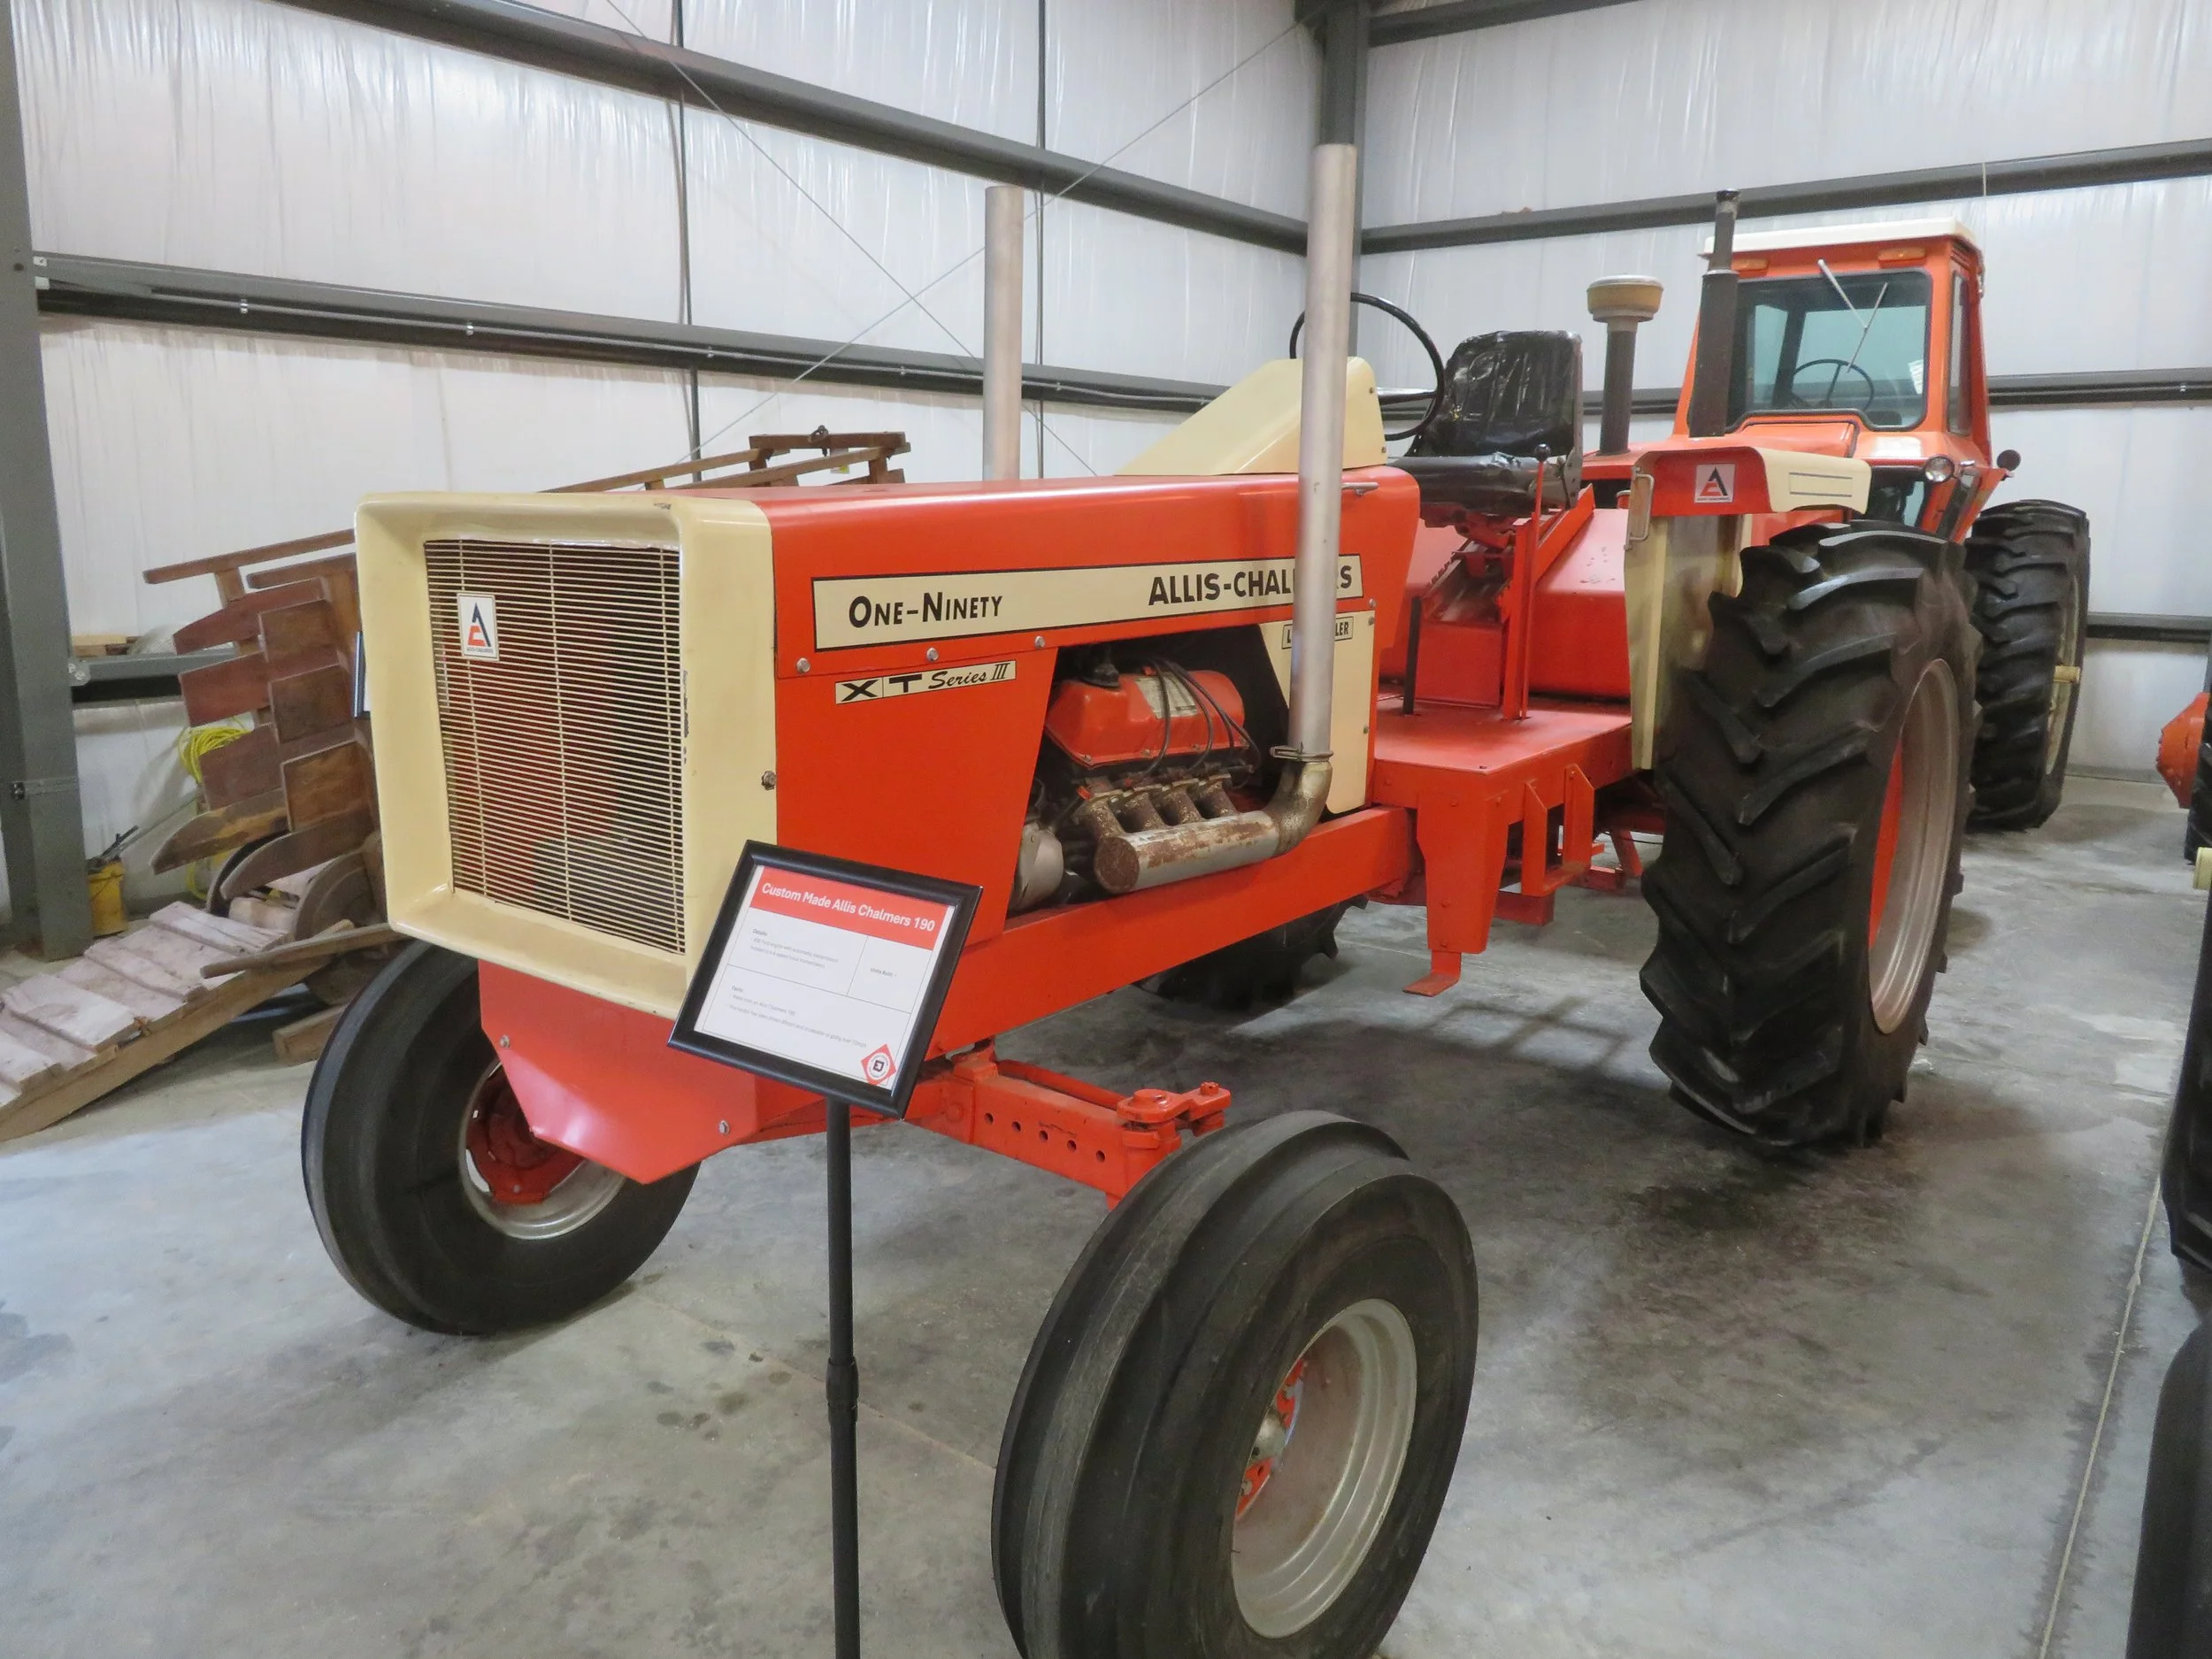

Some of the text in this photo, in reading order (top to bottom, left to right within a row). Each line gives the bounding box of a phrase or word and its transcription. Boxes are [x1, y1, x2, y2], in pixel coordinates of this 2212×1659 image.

[1148, 565, 1352, 606] ALLIS-CHALS
[928, 671, 987, 689] Series
[990, 663, 1011, 681] III
[761, 882, 935, 932] Custom Made Allis Chalmers 190
